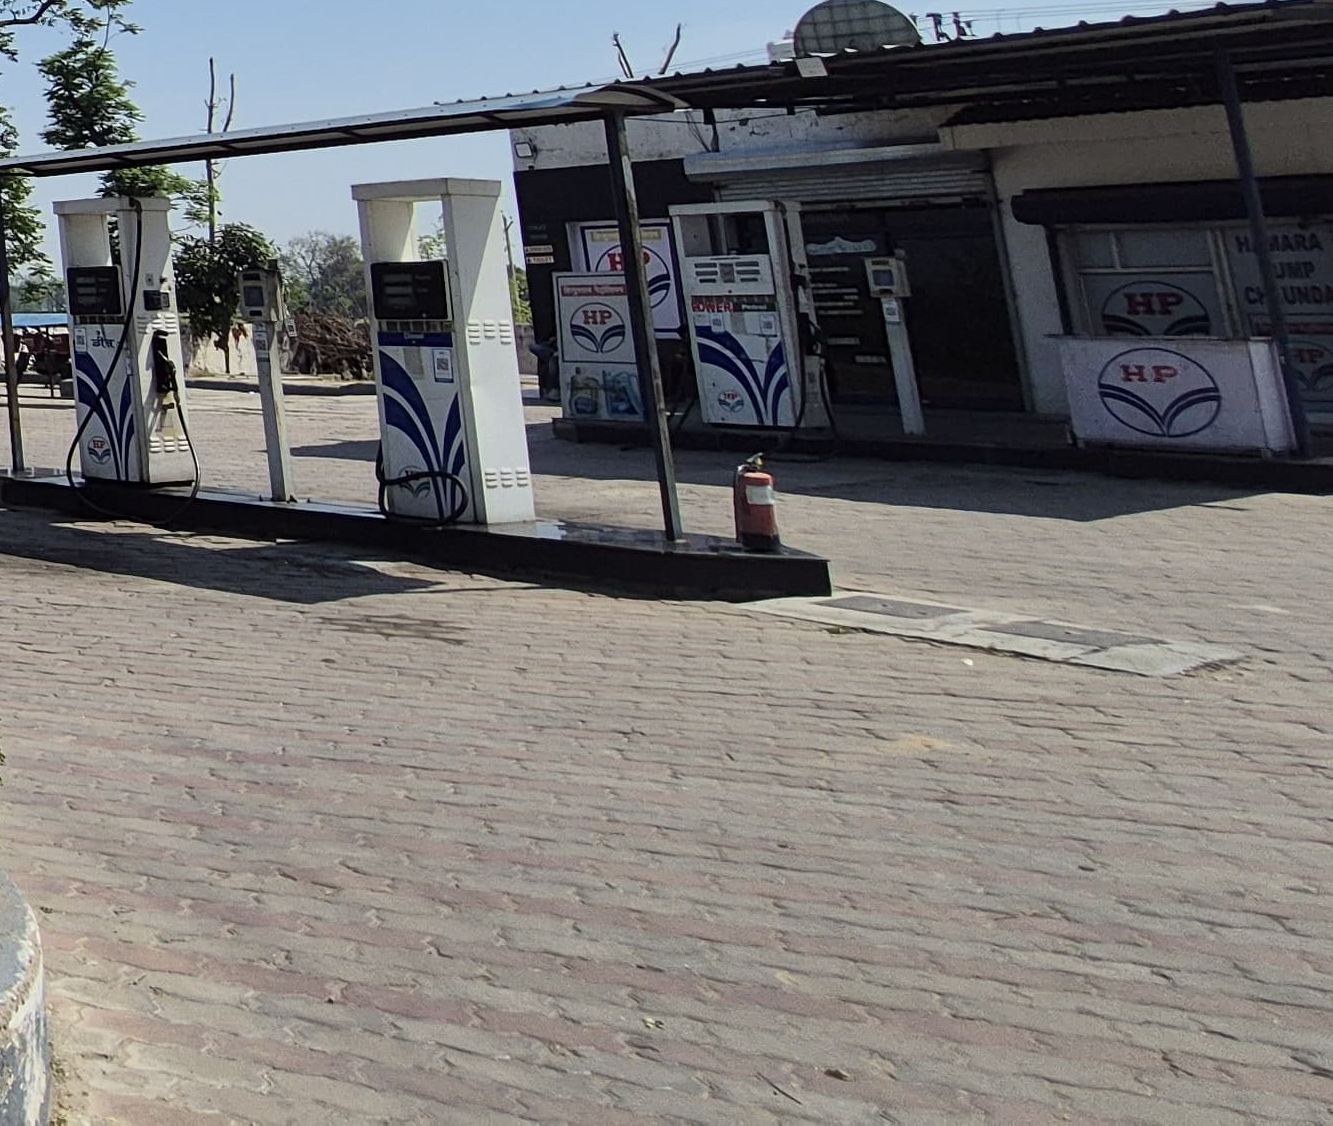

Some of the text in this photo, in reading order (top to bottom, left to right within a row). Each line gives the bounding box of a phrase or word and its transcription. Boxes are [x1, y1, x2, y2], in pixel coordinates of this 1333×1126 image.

[1123, 292, 1183, 315] HP
[582, 310, 613, 325] HP
[1119, 364, 1179, 384] HP
[92, 440, 106, 449] HP
